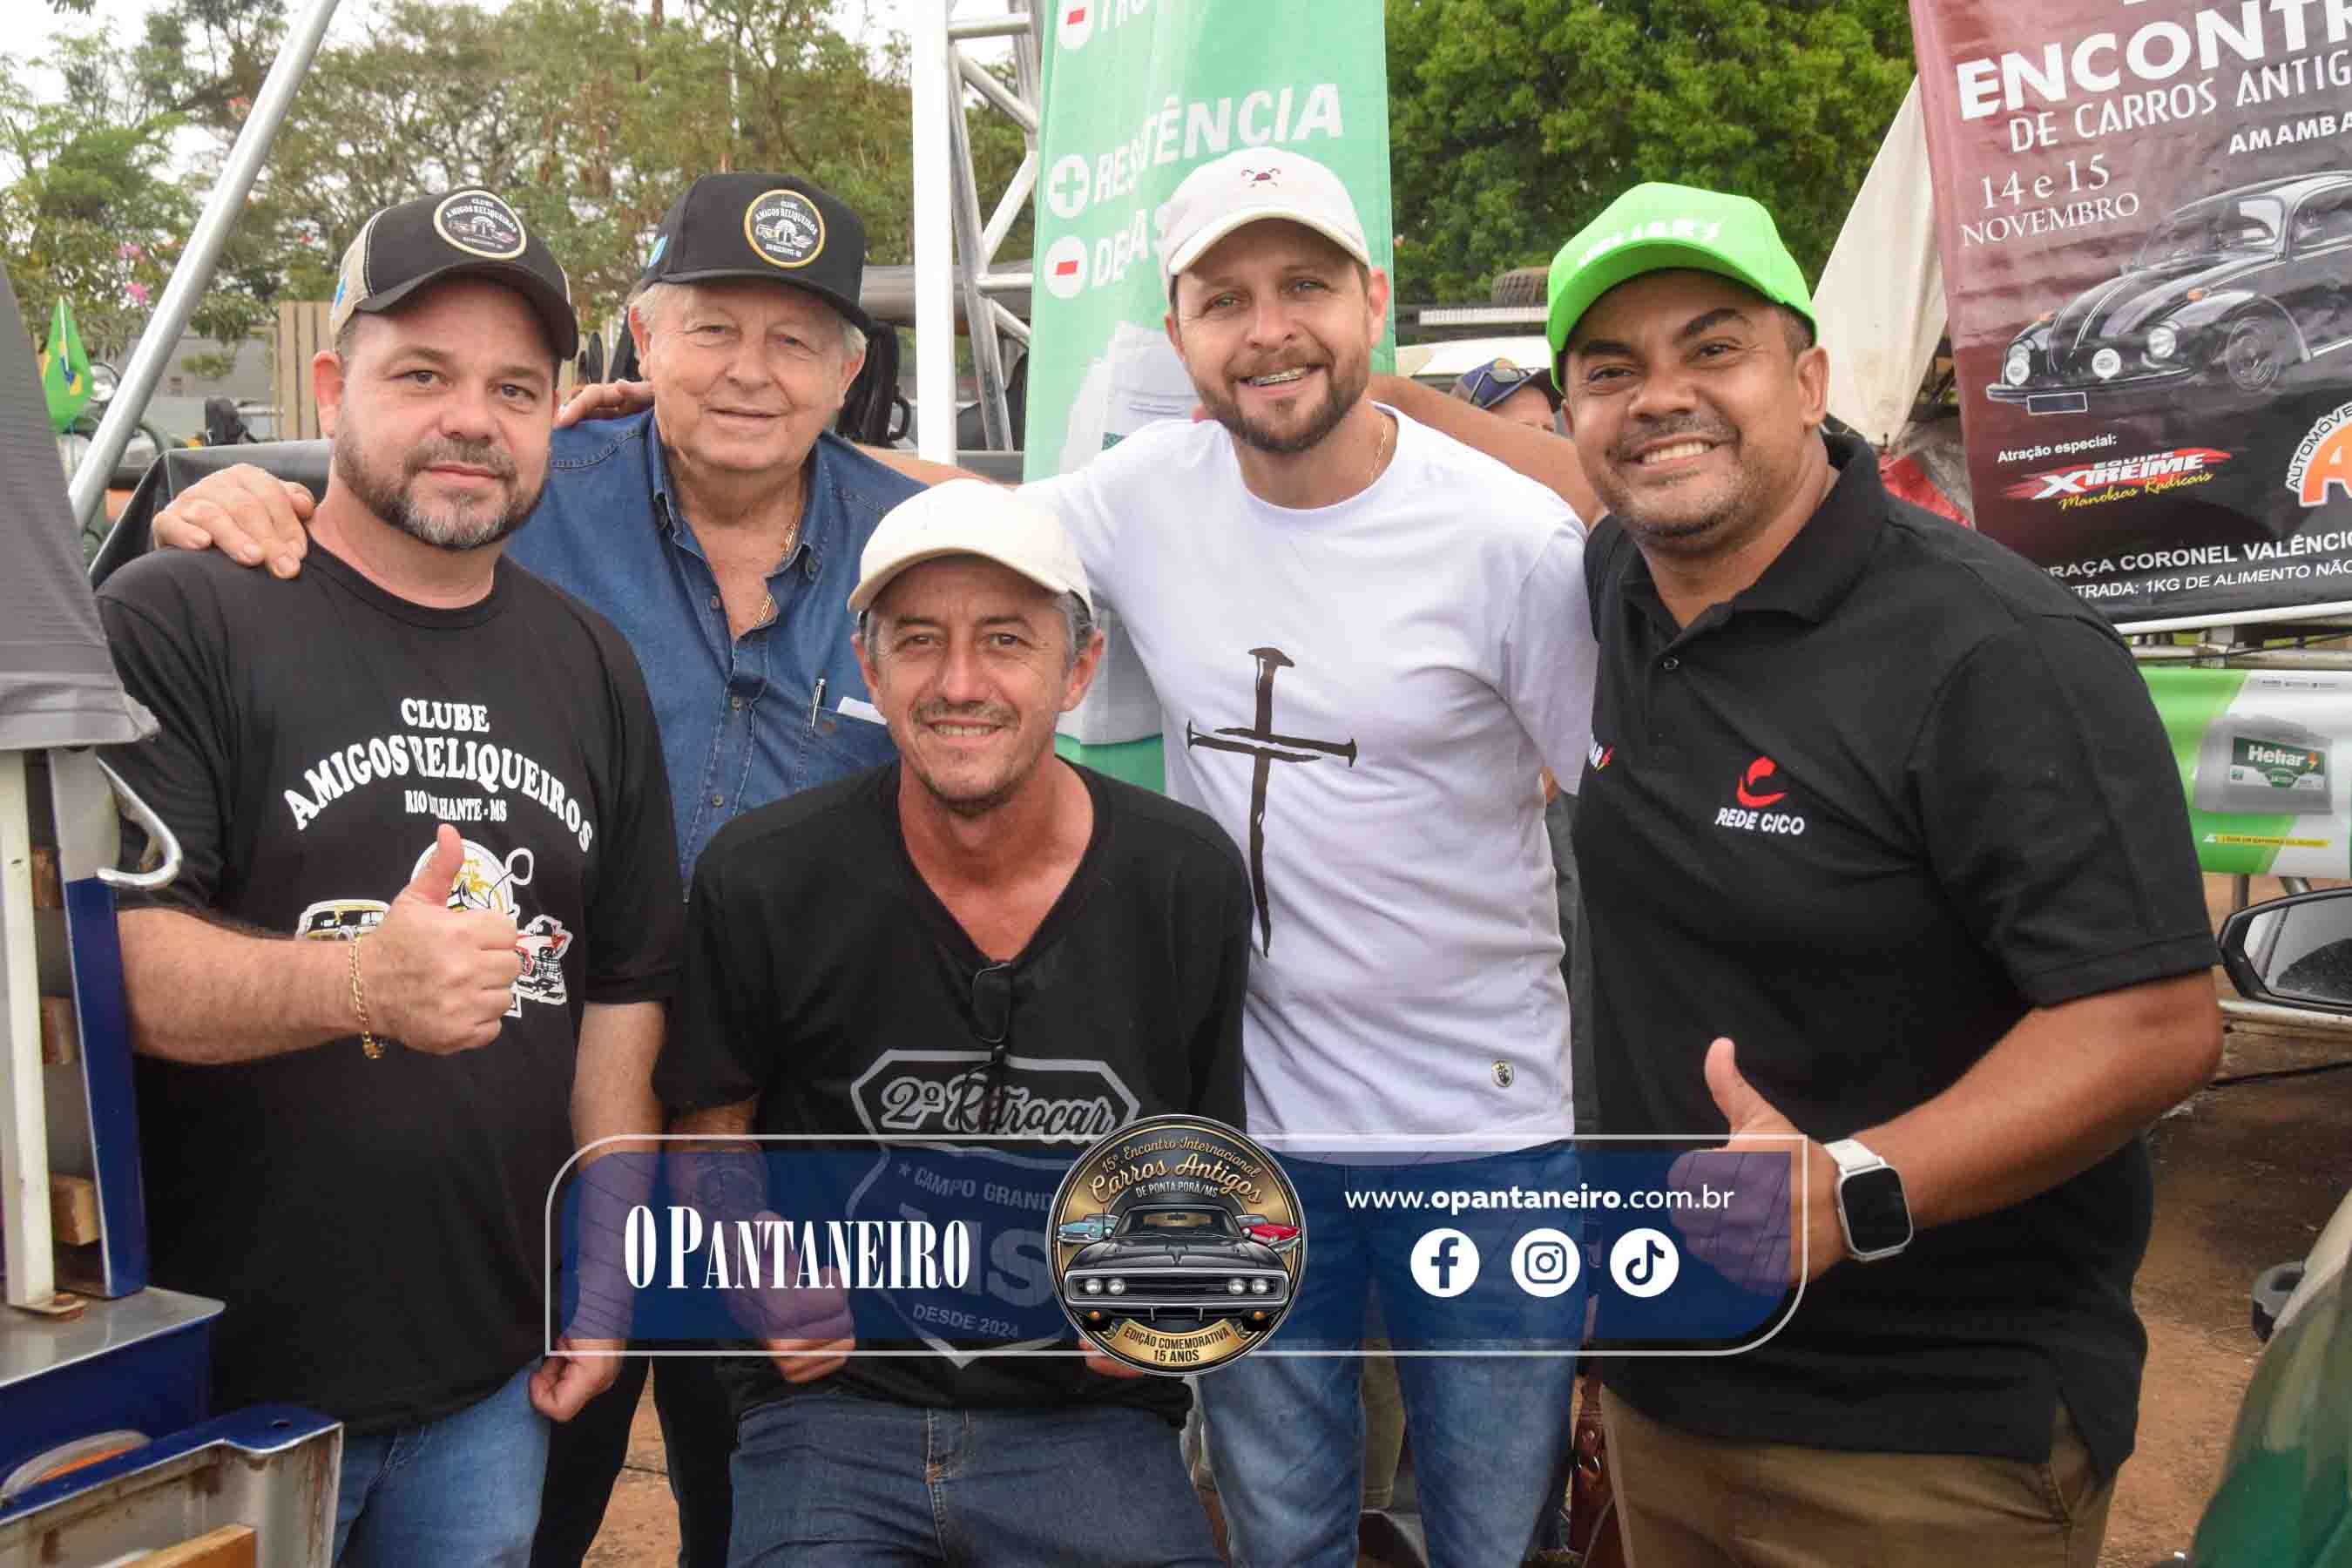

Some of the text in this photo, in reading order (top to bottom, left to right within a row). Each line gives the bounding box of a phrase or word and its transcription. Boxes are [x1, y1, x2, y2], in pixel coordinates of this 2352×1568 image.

[2009, 111, 2059, 152] DE
[2074, 77, 2218, 139] CARROS
[1981, 153, 2111, 211] 14 e 15
[1960, 192, 2140, 249] NOVEMBRO
[1997, 433, 2117, 464] Atração especial:
[2058, 471, 2214, 509] Manobras Radicais
[2041, 558, 2116, 578] RAÇA
[2119, 545, 2237, 571] CORONEL
[2145, 578, 2180, 594] 1KG
[2185, 575, 2211, 591] DE
[2214, 564, 2311, 586] ALIMENTO
[401, 698, 490, 733] CLUBE
[2248, 745, 2307, 767] Heliar
[283, 734, 592, 853] AMIGOS RELIQUEIROS
[404, 789, 428, 814] RIO
[490, 799, 507, 821] MS
[1714, 808, 1806, 836] REDE CICO
[915, 1166, 977, 1198] CAMPO
[913, 1304, 1019, 1339] DESDE 2024
